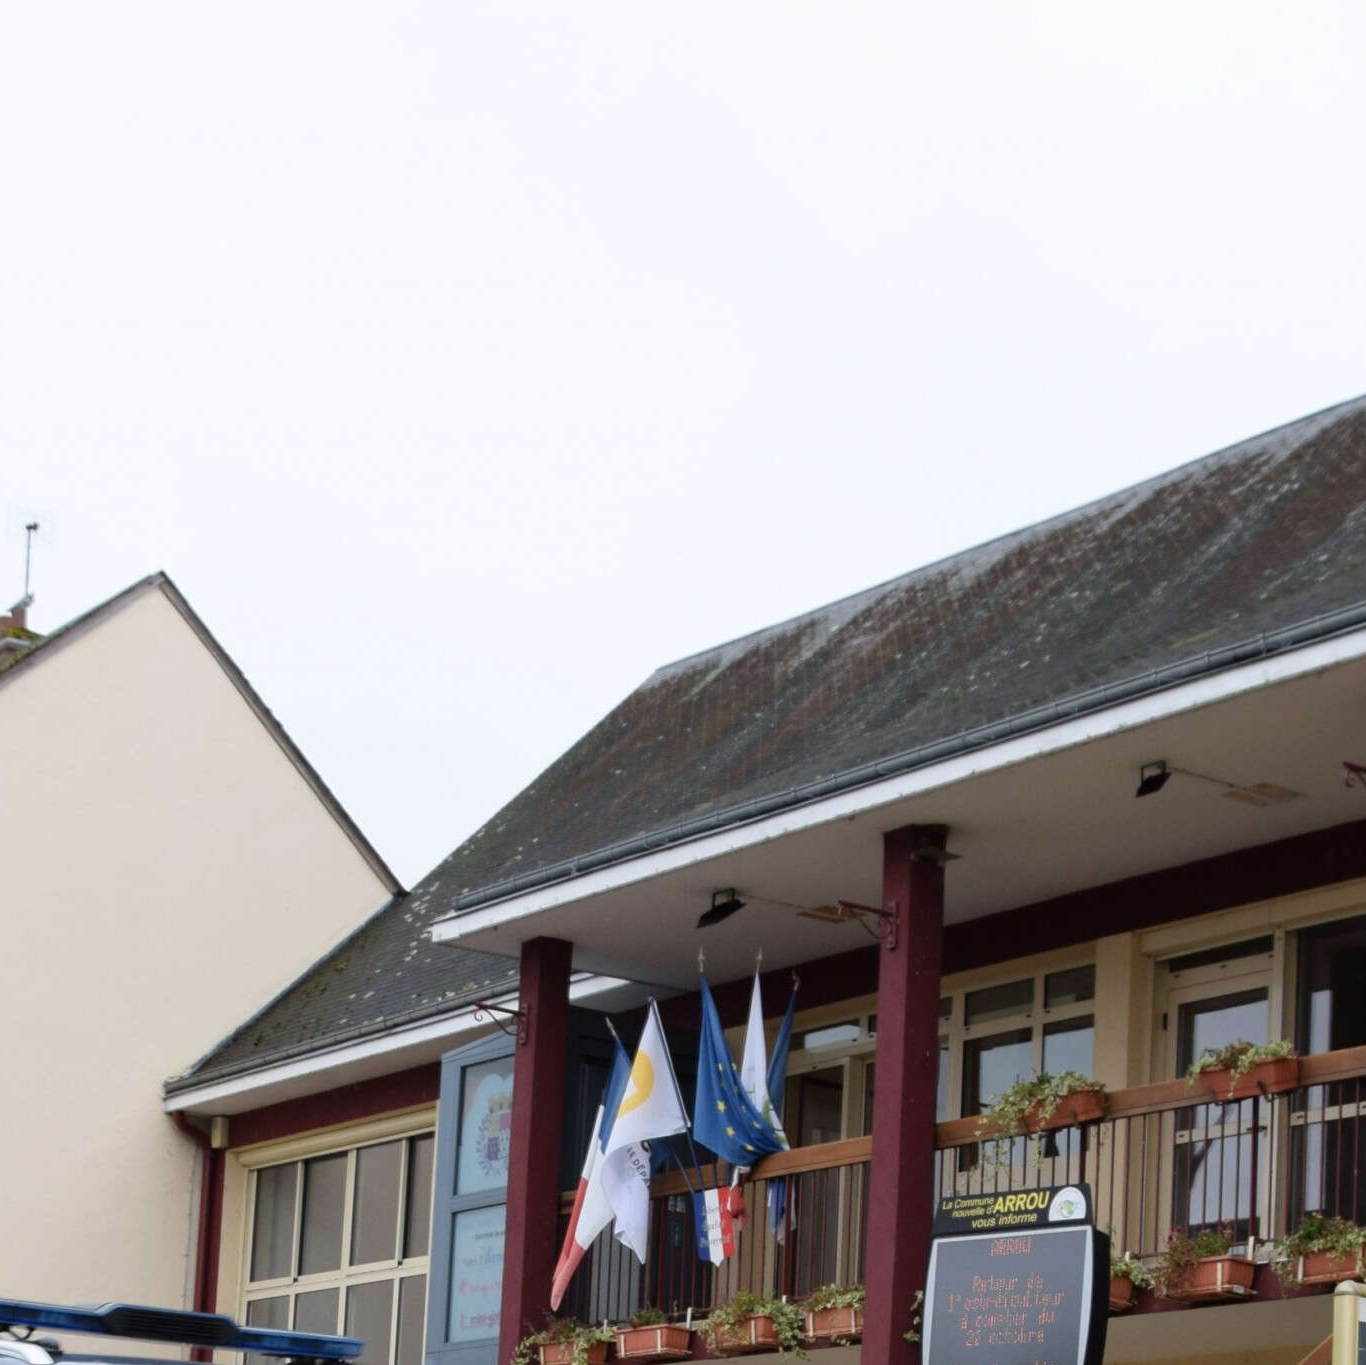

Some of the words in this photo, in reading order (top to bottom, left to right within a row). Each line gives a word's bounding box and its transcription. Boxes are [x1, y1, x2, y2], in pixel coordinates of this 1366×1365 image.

[942, 1200, 953, 1210] La
[955, 1198, 995, 1209] Commune
[952, 1208, 985, 1219] nouvelle
[971, 1218, 996, 1229] vous
[998, 1213, 1038, 1225] informe
